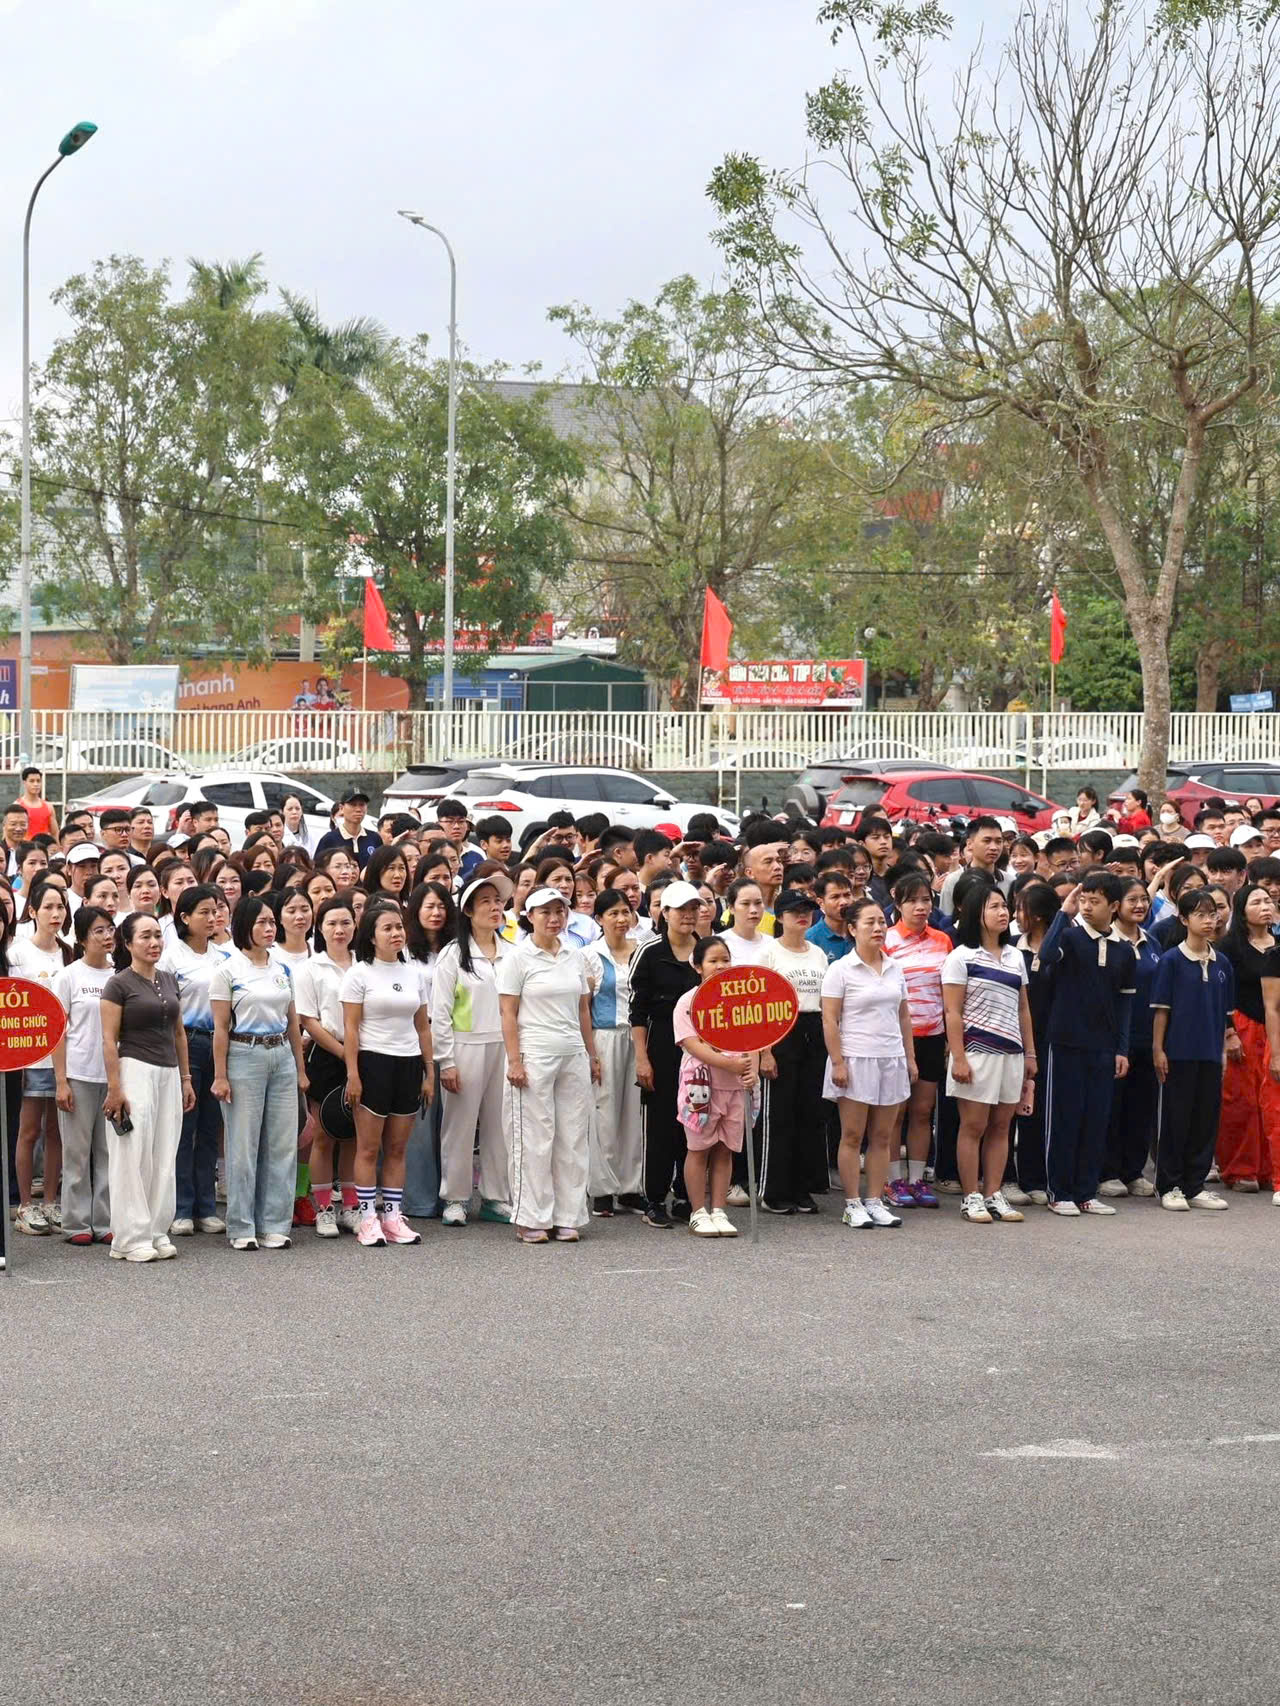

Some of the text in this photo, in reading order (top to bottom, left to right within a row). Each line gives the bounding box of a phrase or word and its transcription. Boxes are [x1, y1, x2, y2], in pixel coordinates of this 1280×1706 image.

[720, 970, 767, 997] KHỐI
[23, 1013, 48, 1028] CHỨC
[697, 1010, 705, 1030] Y
[732, 1001, 763, 1027] GIÁO
[766, 1000, 793, 1026] DỤC
[7, 1035, 33, 1049] UBND
[35, 1033, 48, 1047] XÃ
